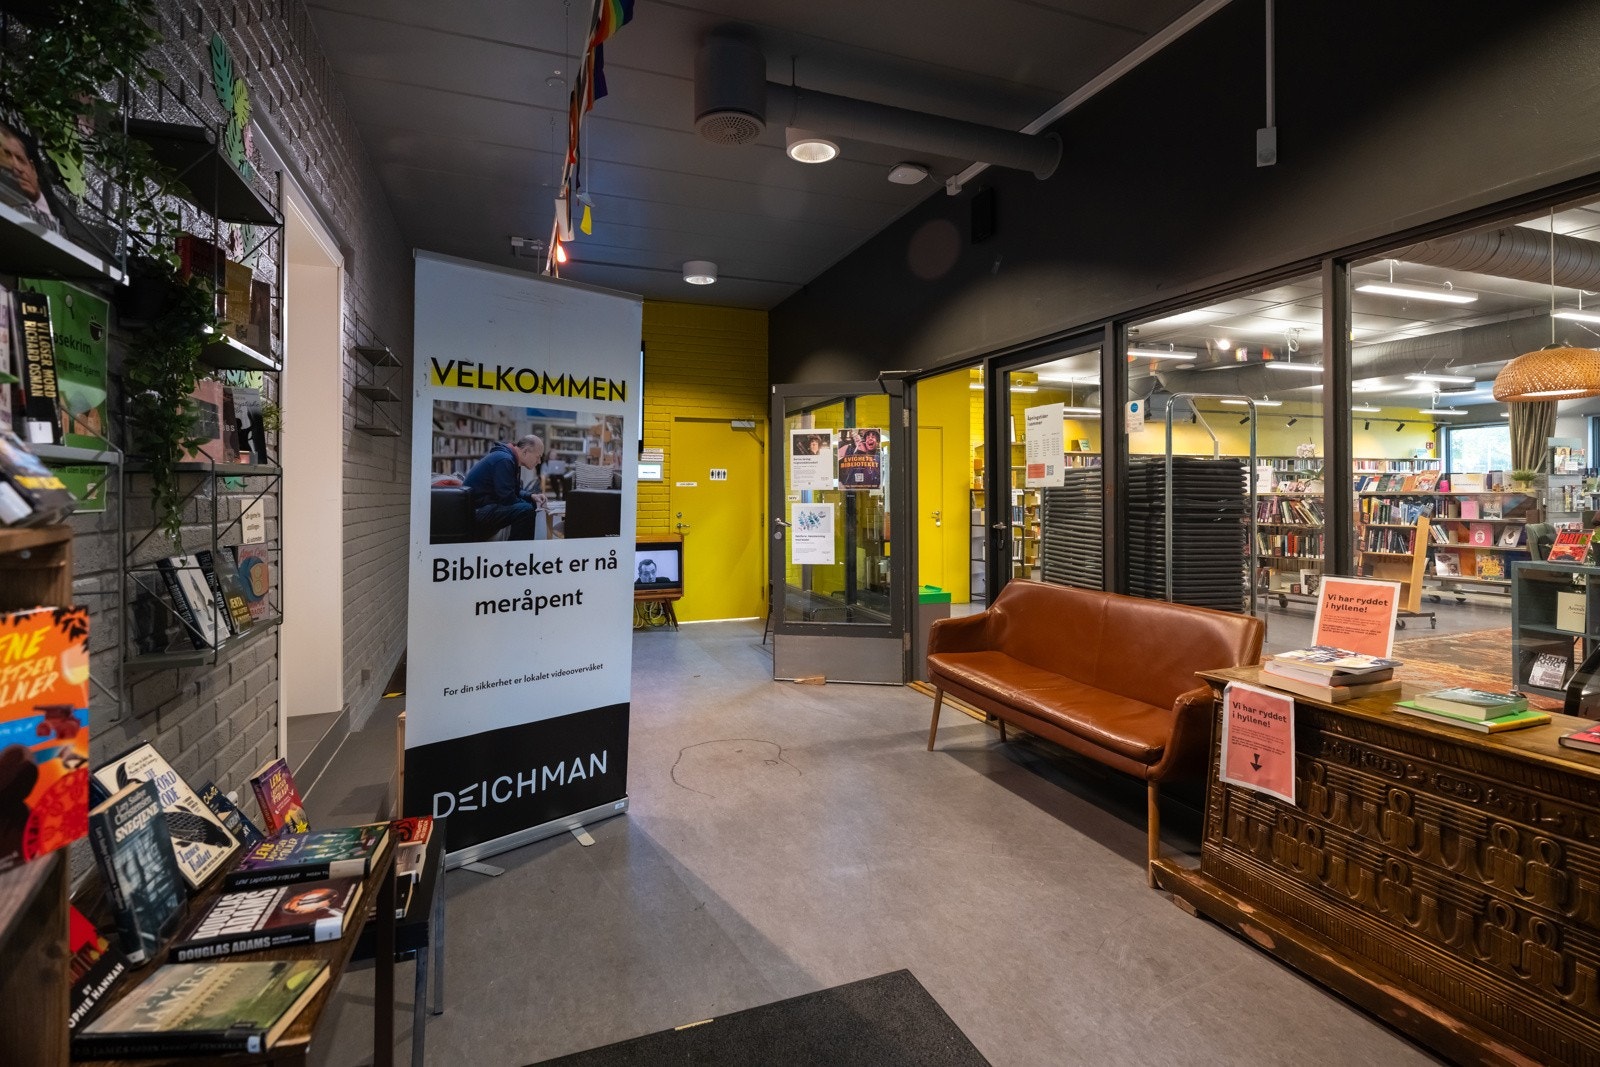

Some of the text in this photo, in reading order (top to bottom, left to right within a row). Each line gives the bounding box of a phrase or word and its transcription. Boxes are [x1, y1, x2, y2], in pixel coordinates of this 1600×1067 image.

[24, 321, 40, 361] RICHARD
[54, 333, 91, 355] osekrim
[28, 363, 43, 397] OSMAN
[43, 369, 56, 398] MORD
[431, 357, 626, 403] VELKOMMEN
[432, 550, 618, 583] Biblioteket er nå
[476, 588, 583, 616] meråpent
[1327, 594, 1388, 607] Vi har ryddet
[1330, 602, 1368, 613] hyllene!
[443, 663, 603, 697] For din sikkerhet er lokalet videoovervåket
[1232, 701, 1287, 723] Vi har ryddet
[1237, 711, 1271, 729] hyllene!
[155, 770, 177, 790] FORD
[433, 750, 607, 819] DEICHMAN
[251, 842, 275, 860] LENE
[178, 942, 230, 961] DOUGLAS
[232, 937, 271, 953] ADAMS
[82, 984, 92, 995] BY
[92, 962, 125, 1000] HANNAH
[134, 965, 217, 1031] JAMES
